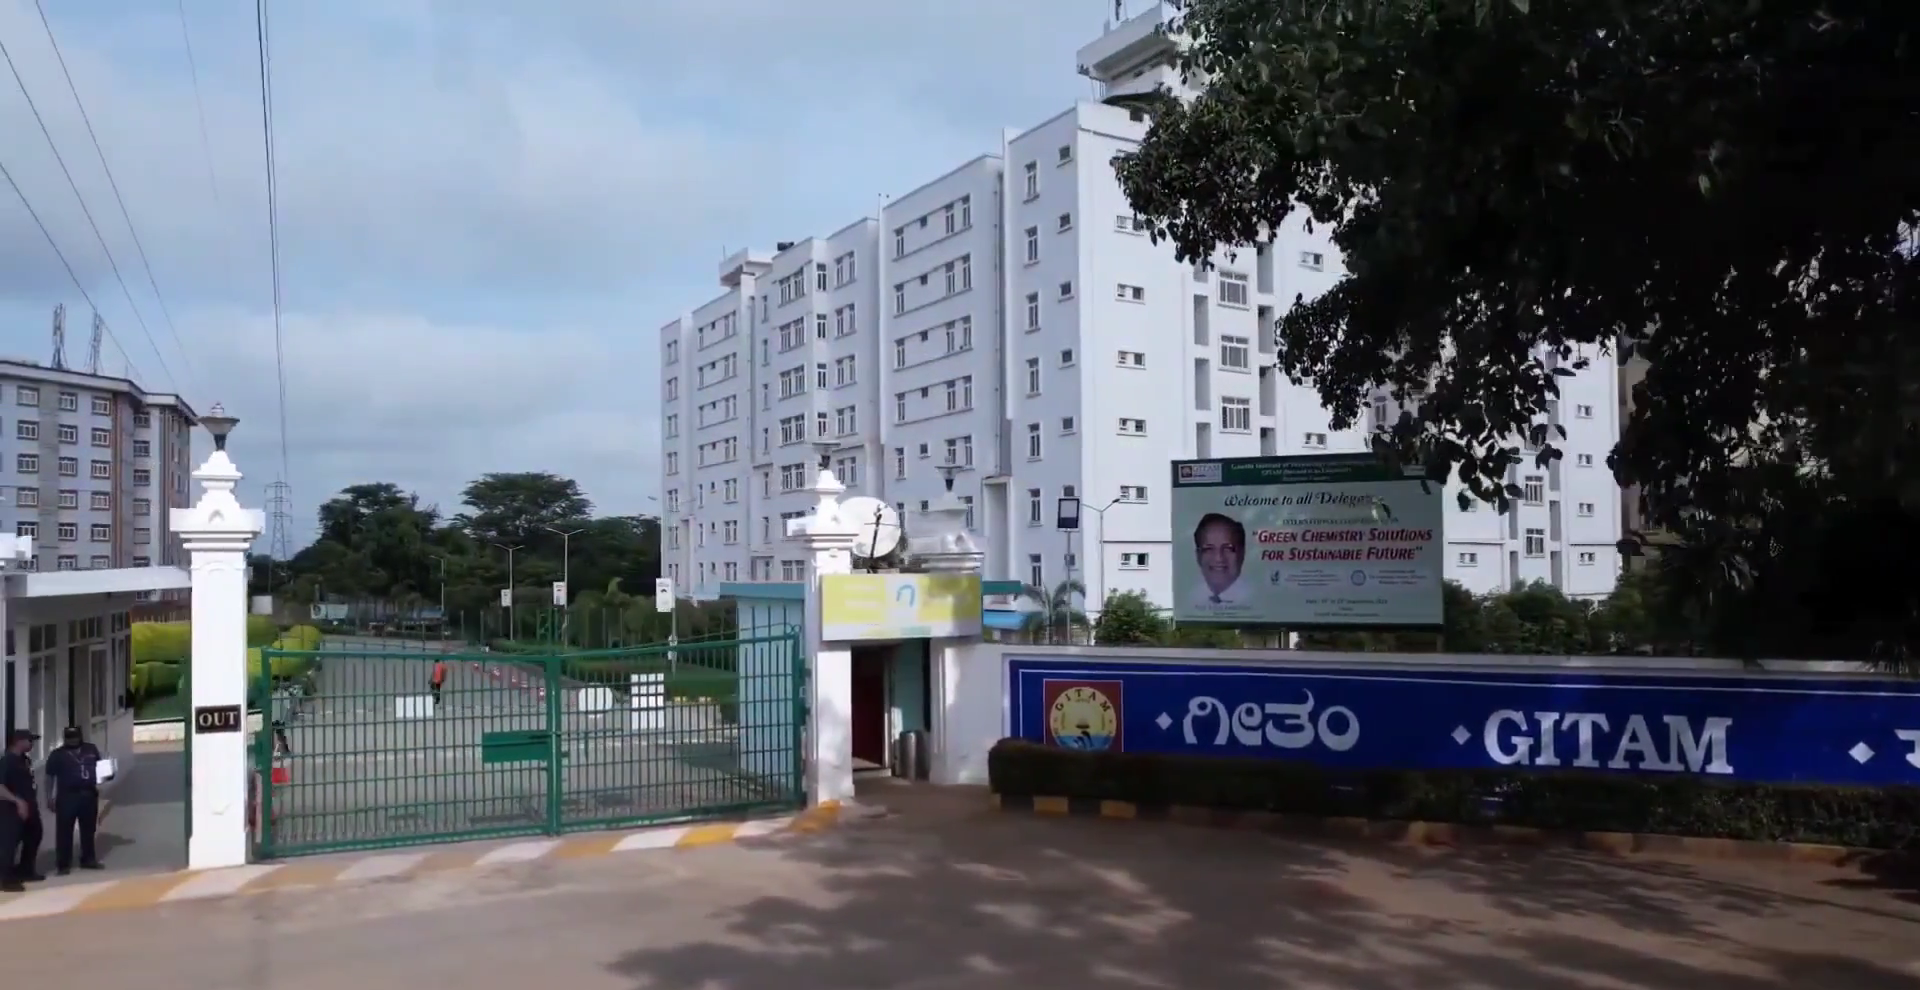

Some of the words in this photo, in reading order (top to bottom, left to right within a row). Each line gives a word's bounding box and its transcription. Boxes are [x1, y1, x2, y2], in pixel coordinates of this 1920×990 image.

[1224, 493, 1279, 506] Welcome
[1282, 495, 1293, 505] to
[1296, 491, 1313, 505] all
[1055, 688, 1111, 712] GITAM
[199, 711, 238, 727] OUT
[1483, 708, 1734, 774] GITAM
